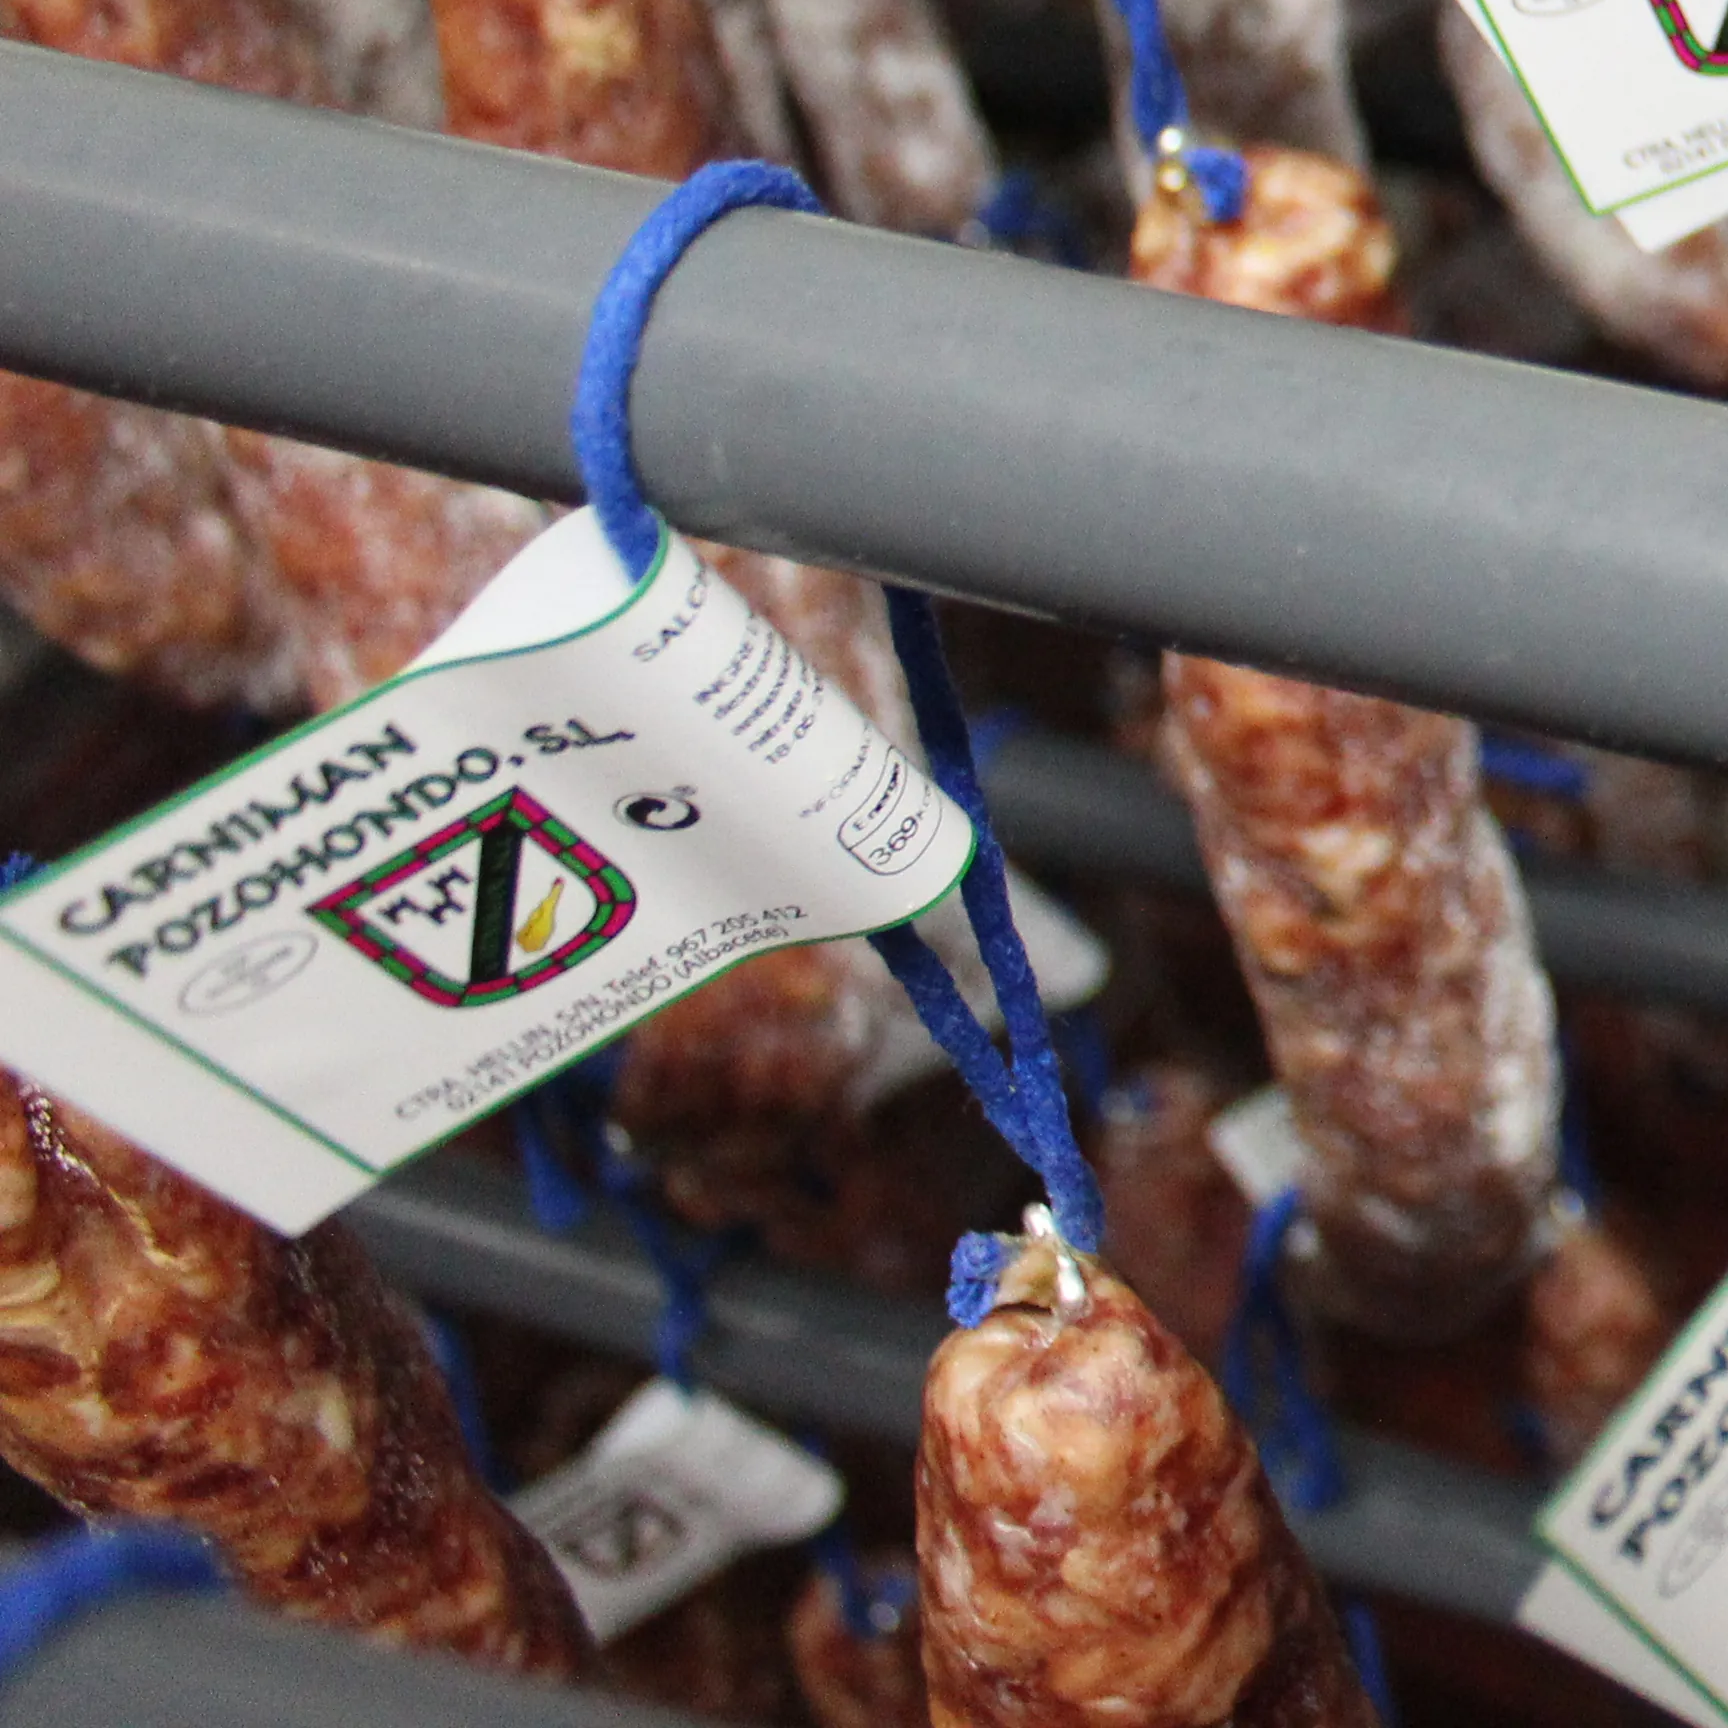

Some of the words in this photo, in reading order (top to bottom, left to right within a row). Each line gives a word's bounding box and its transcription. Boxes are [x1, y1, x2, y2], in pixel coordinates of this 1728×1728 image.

[59, 724, 417, 938] CARNIMAN
[868, 815, 919, 866] 369
[666, 928, 708, 960] 967
[711, 912, 759, 936] 205
